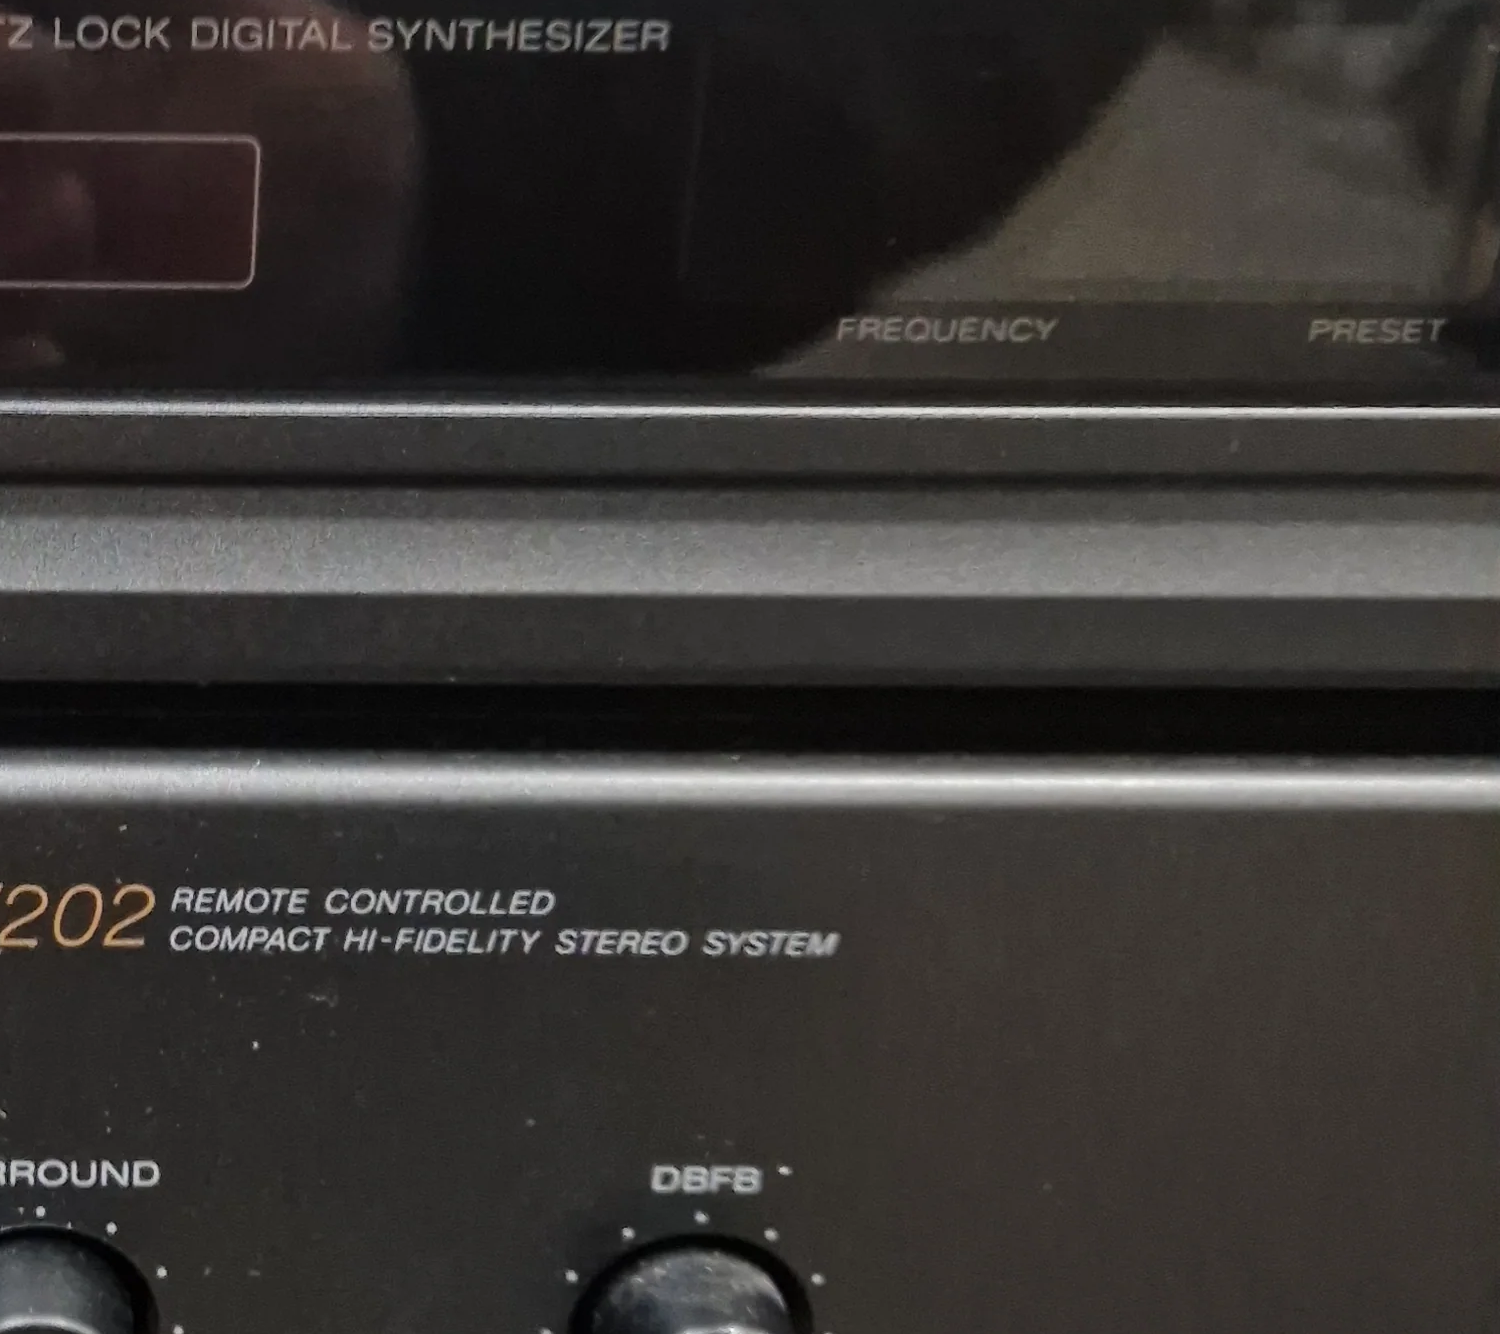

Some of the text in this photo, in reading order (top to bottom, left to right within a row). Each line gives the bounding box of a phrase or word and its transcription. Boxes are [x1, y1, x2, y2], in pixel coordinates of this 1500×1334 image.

[52, 17, 171, 51] LOCK
[190, 18, 353, 53] DIGITAL
[366, 18, 672, 55] SYNTHESIZER
[836, 316, 1058, 344] FREQUENCY
[1308, 318, 1448, 344] PRESET
[170, 887, 556, 917] REMOTE CONTROLLED
[169, 926, 841, 958] COMPACT HI-FIDELITY STEREO SYSTEM
